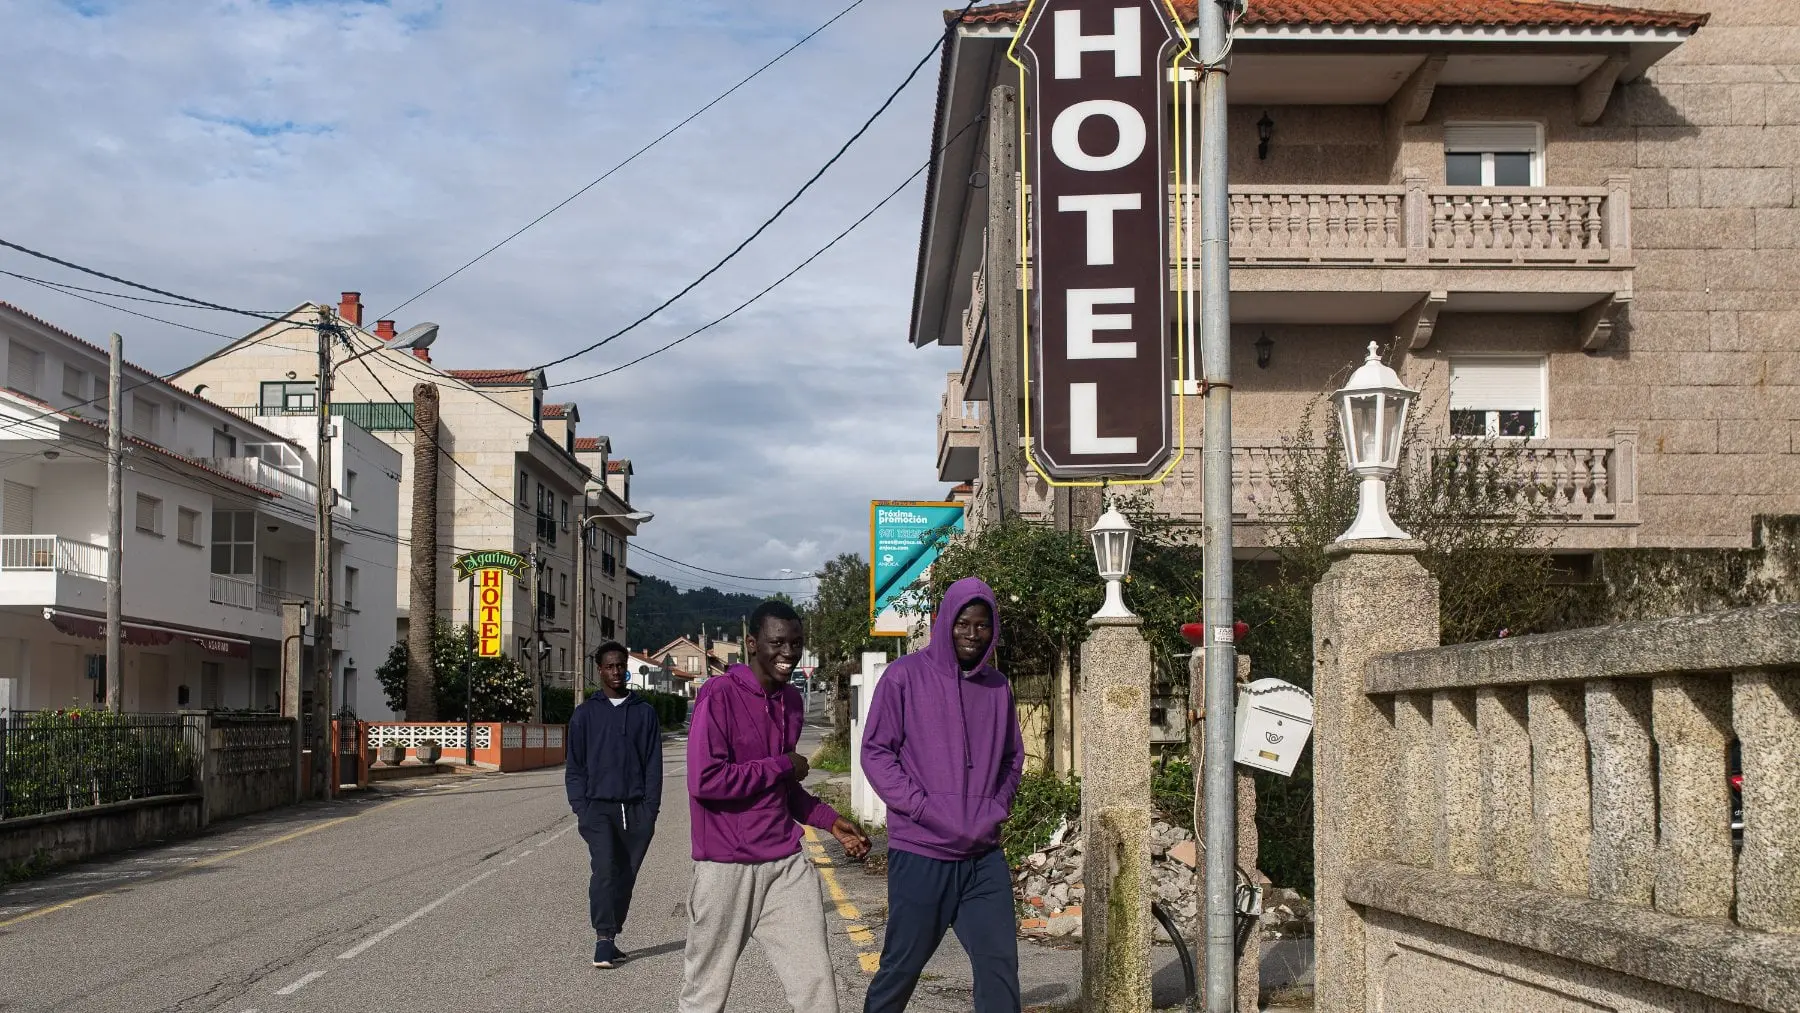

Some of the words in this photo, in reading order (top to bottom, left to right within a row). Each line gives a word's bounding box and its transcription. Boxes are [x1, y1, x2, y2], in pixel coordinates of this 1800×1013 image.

[1051, 6, 1147, 456] HOTEL
[879, 515, 928, 524] promoción
[464, 552, 517, 569] Agarimo
[481, 571, 499, 655] HOTEL
